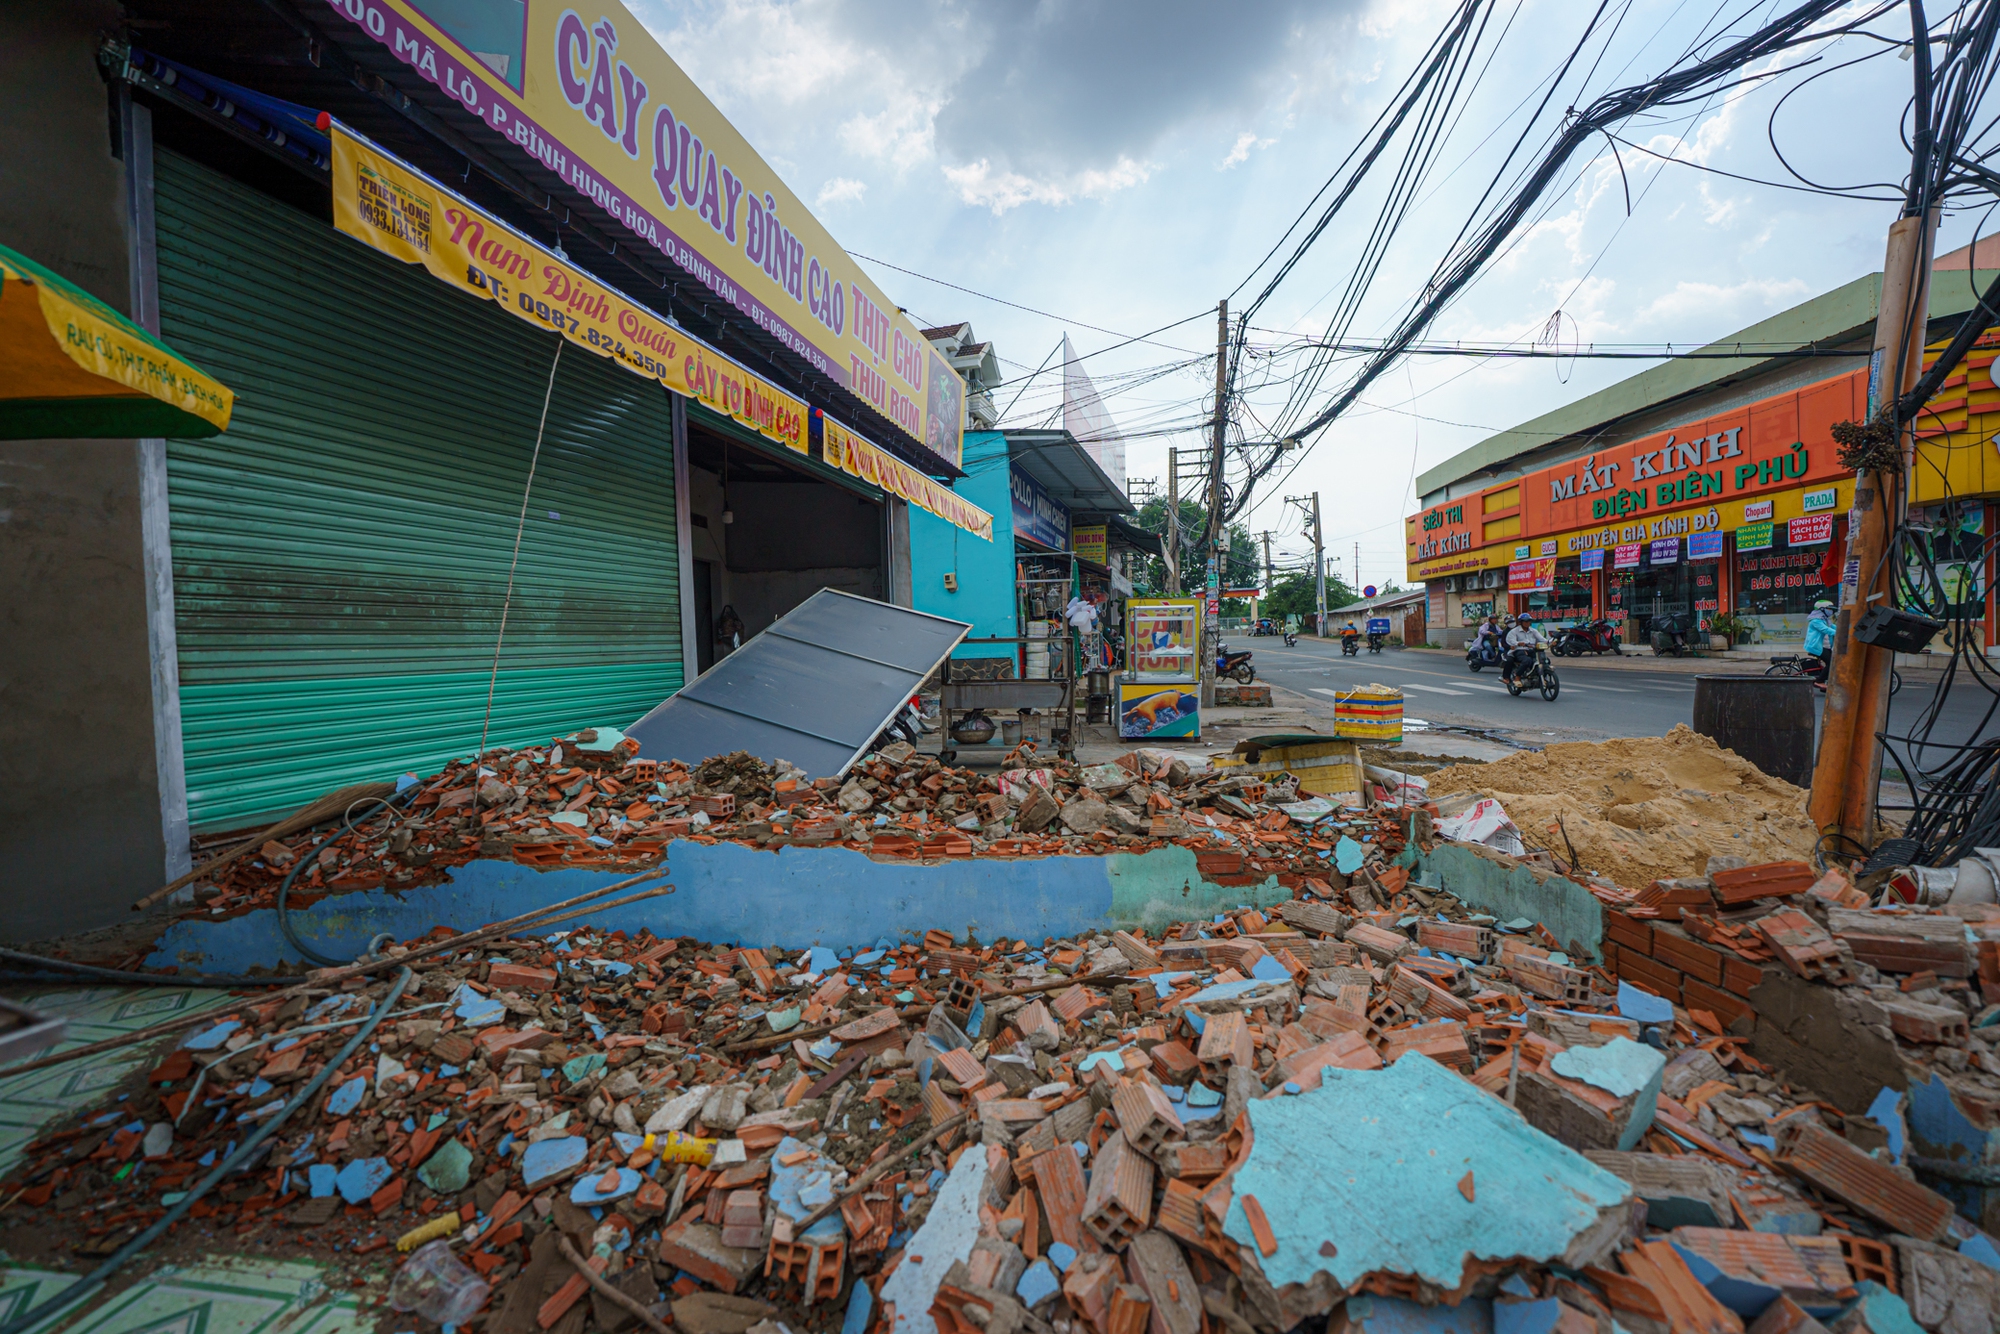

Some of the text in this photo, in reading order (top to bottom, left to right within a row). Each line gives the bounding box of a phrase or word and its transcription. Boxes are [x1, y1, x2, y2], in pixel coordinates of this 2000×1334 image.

[331, 0, 385, 36] 00
[395, 27, 438, 80] MÃ
[572, 164, 621, 217] HƯNG
[714, 274, 737, 305] TÂN
[752, 304, 768, 328] ĐT:
[770, 319, 792, 346] 0987
[794, 338, 810, 360] 824
[812, 351, 827, 372] 350
[556, 11, 844, 337] CẦY QUAY ĐỈNH CAO
[360, 200, 430, 252] 0933.134.754
[401, 198, 430, 225] LONG
[445, 208, 677, 359] Nam Định Quán
[466, 264, 667, 379] ĐT: 0987.824.350
[852, 282, 923, 393] THỊT CHÓ
[850, 351, 921, 437] THUI RƠM
[776, 405, 800, 443] CAO
[1550, 427, 1742, 503] MẮT KÍNH
[1592, 442, 1808, 519] ĐIỆN BIÊN PHỦ
[1745, 504, 1771, 518] Chopard
[1804, 492, 1834, 508] PRADA
[1568, 507, 1719, 551] CHUYÊN GIA KÍNH ĐỘ
[1791, 515, 1831, 526] KÍNH ĐỌC
[1791, 526, 1812, 535] SÁCH
[1440, 531, 1471, 554] KÍNH
[1737, 556, 1757, 571] LÀM
[1761, 554, 1785, 570] KÍNH
[1787, 552, 1816, 567] THEO
[1696, 575, 1712, 587] GIA
[1751, 574, 1771, 590] BÁC
[1695, 597, 1716, 611] KÍNH
